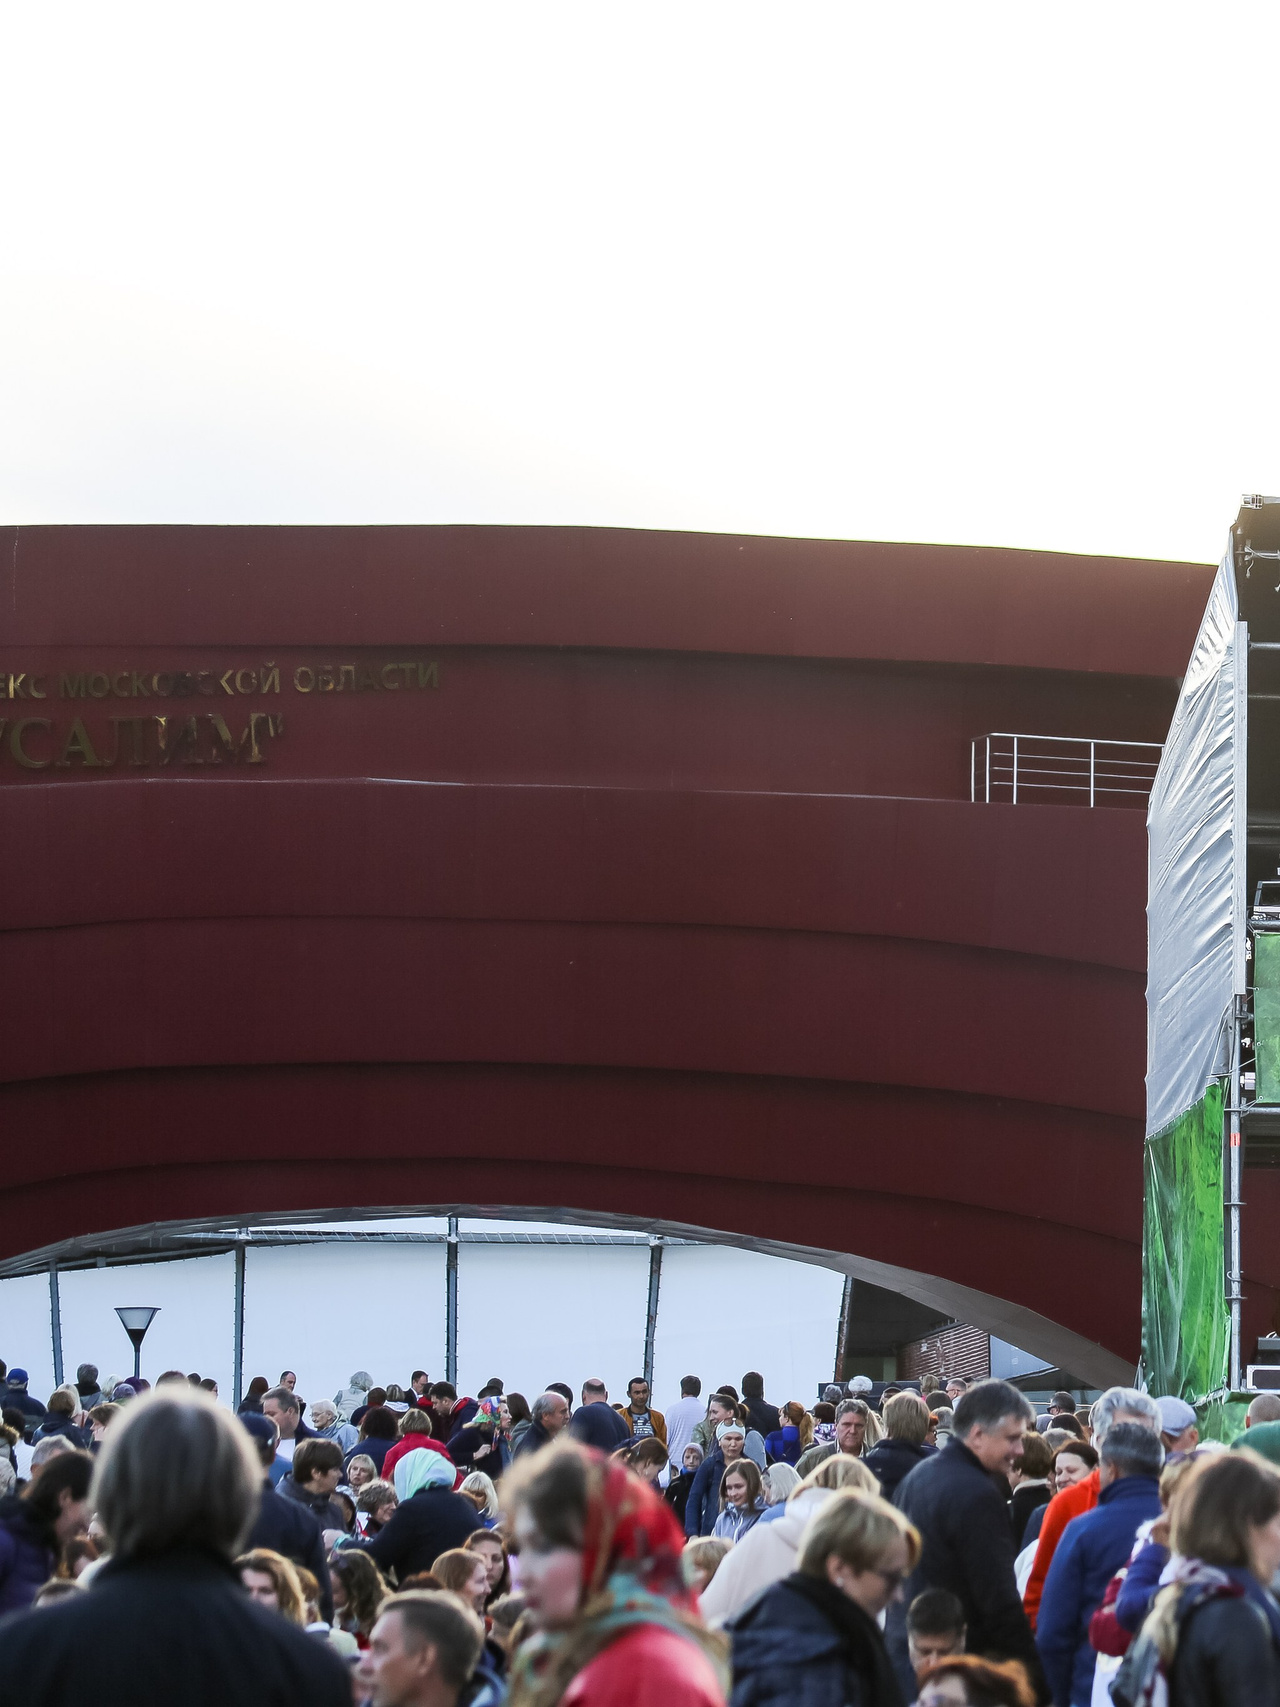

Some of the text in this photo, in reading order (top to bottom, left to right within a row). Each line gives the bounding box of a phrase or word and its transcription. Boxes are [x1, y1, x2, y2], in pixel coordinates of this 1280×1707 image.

[60, 661, 281, 698] МОСКОВСКОЙ
[293, 661, 440, 693] ОБЛАСТИ
[0, 712, 284, 769] САЛИМ"
